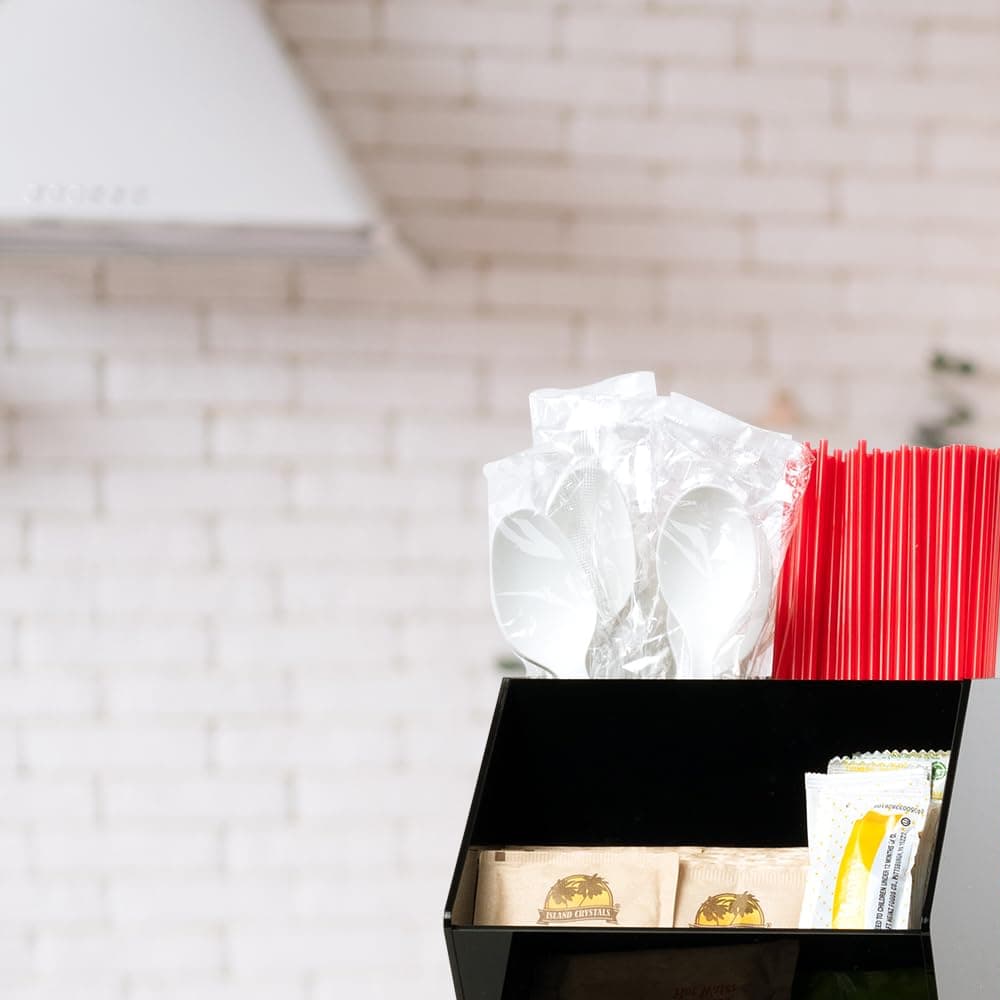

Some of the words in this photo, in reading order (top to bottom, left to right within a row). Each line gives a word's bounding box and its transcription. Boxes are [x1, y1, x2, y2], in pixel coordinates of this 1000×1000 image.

[881, 870, 890, 887] UNDER
[878, 886, 887, 912] CHILDREN
[546, 911, 573, 920] ISLAND
[574, 909, 612, 919] CRYSTALS
